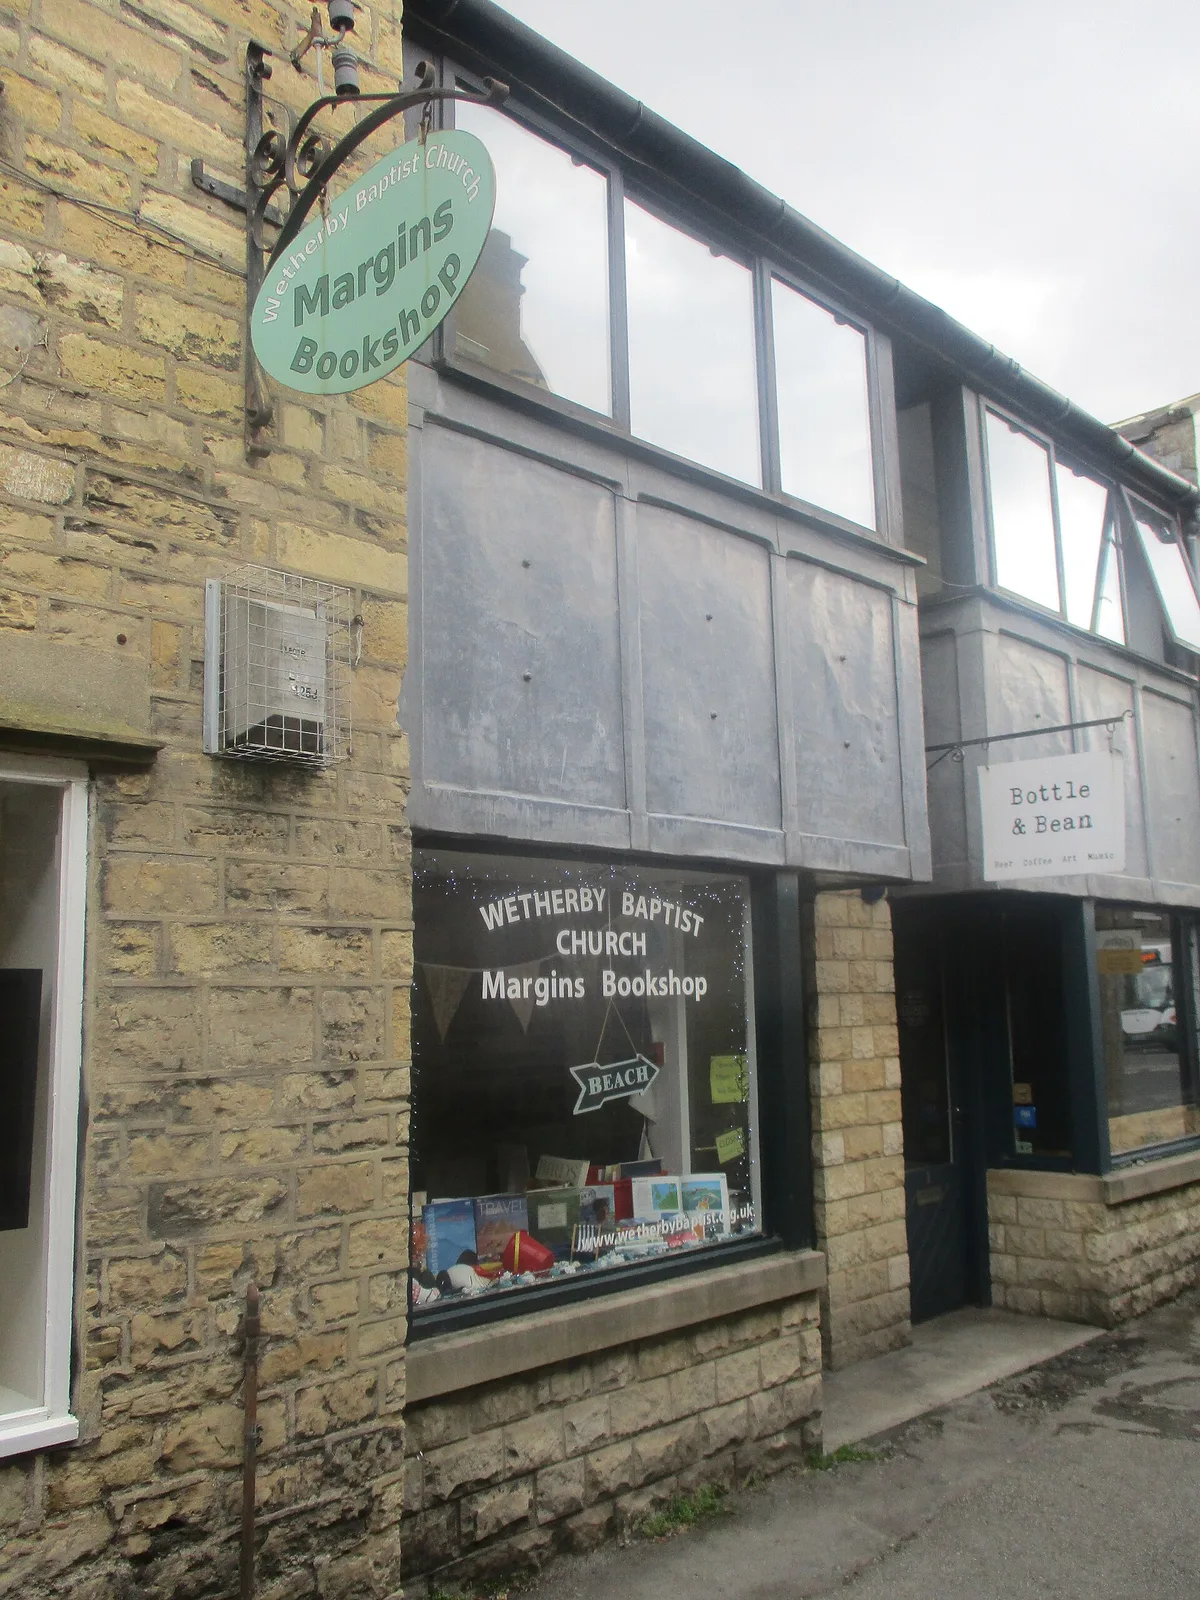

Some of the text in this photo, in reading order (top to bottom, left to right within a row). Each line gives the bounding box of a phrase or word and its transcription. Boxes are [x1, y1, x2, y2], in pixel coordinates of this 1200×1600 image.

[261, 144, 480, 324] Wetherby Baptist Church
[293, 198, 454, 328] Margins
[289, 252, 461, 381] Bookshop
[1009, 781, 1091, 806] Bottle
[1011, 814, 1094, 836] & Bean
[993, 852, 1115, 869] Beer Coffee Art Music
[479, 887, 704, 937] WETHERBY BAPTIST
[556, 929, 648, 956] CHURCH
[481, 968, 708, 1006] Margins Bookshop
[587, 1065, 650, 1096] BEACH
[580, 1203, 755, 1250] www.wetherbybapist.og.uk
